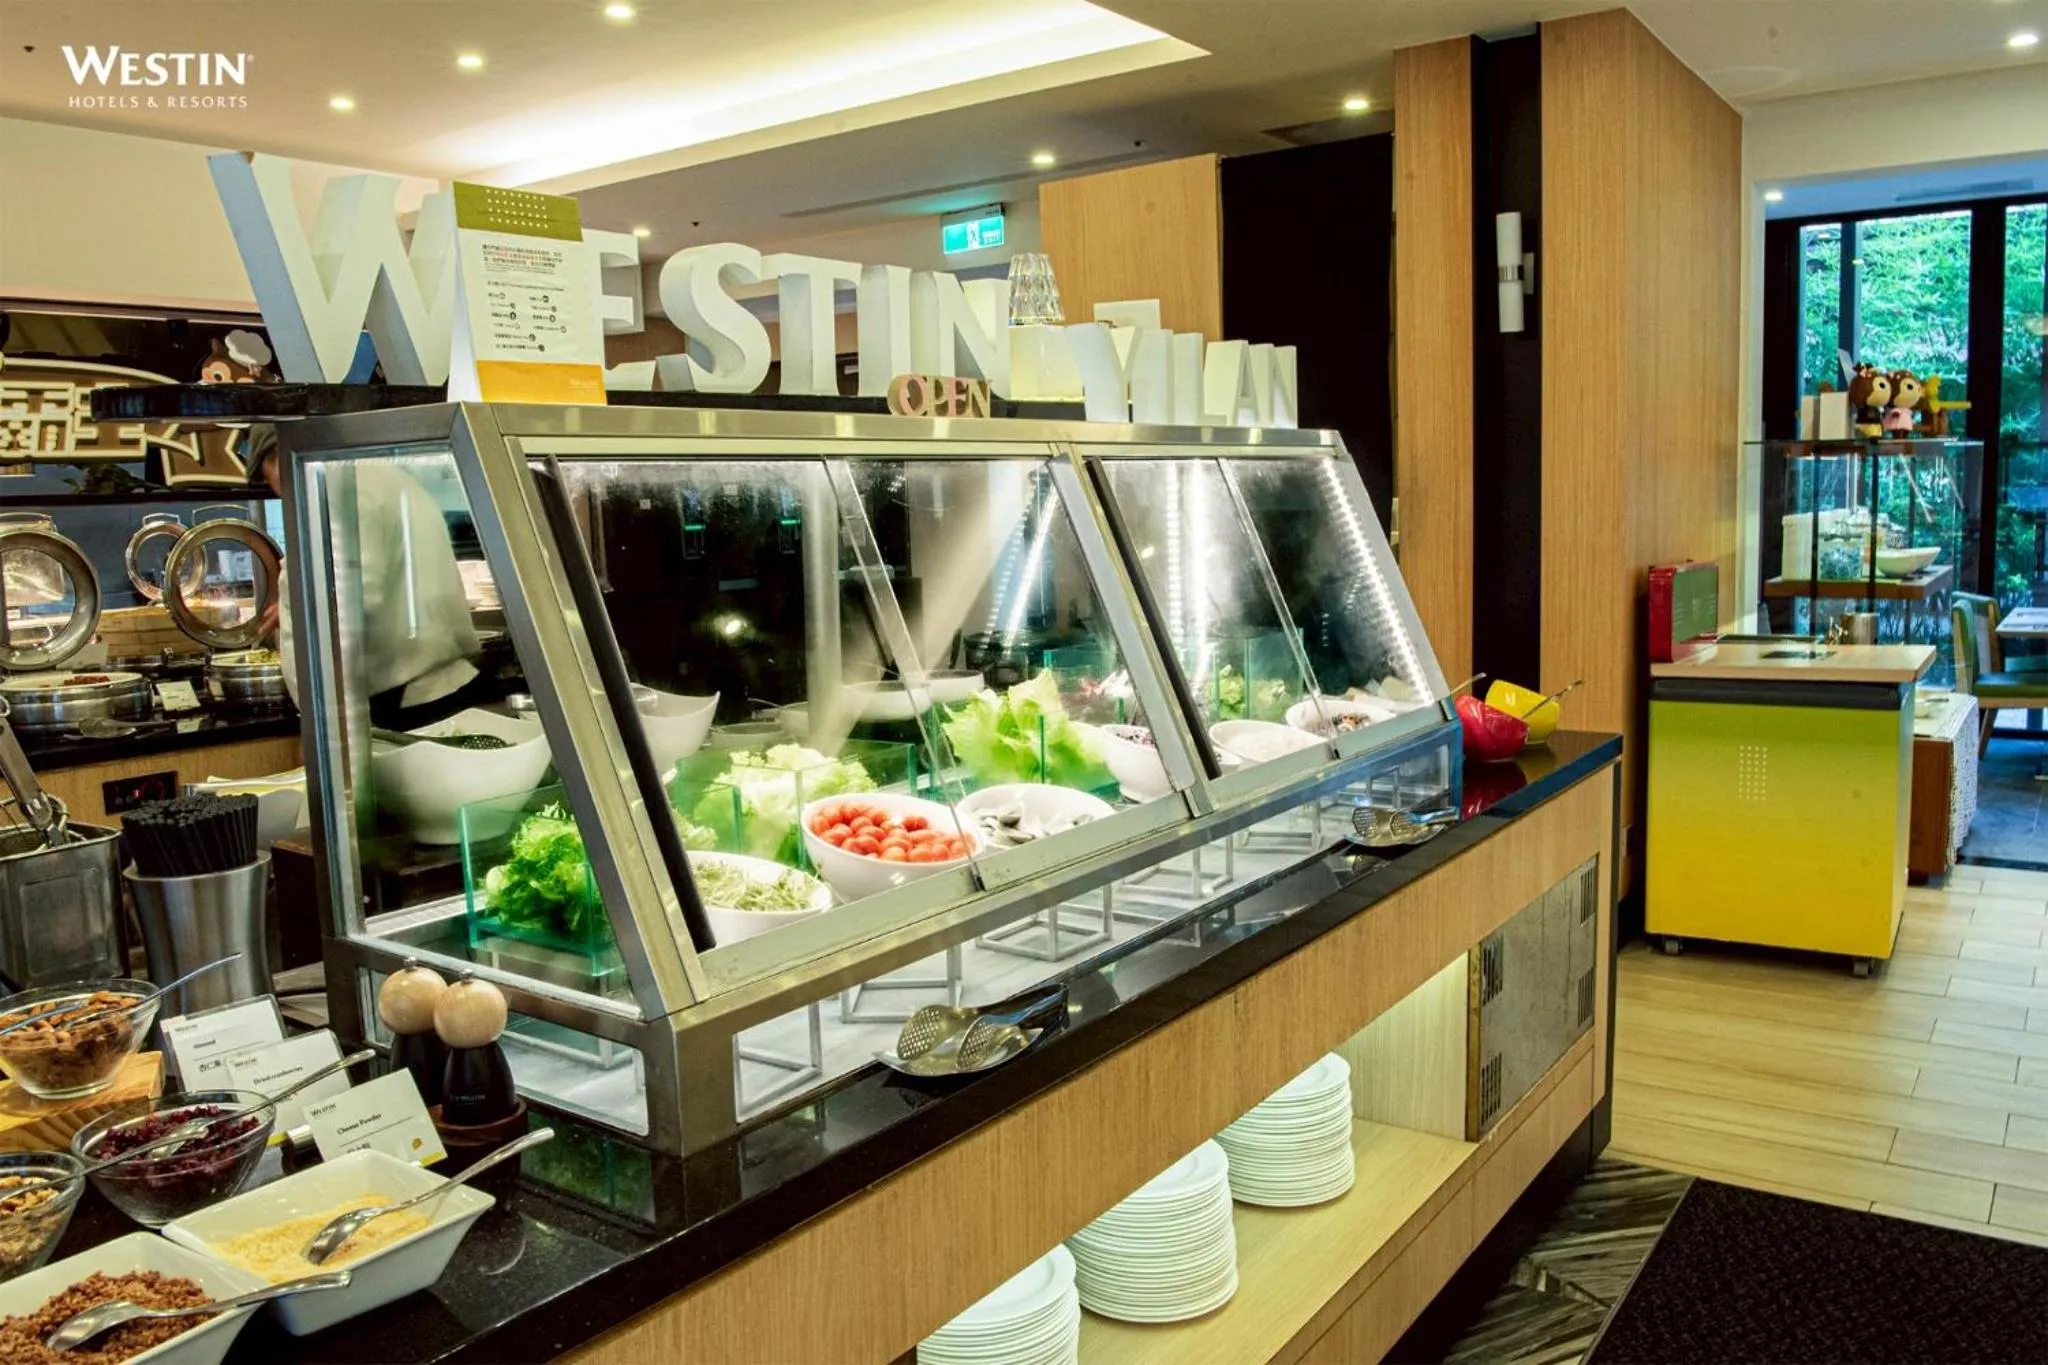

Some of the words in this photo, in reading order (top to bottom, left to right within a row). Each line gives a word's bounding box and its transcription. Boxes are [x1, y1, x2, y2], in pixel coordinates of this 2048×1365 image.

[207, 150, 1010, 399] WESTIN
[1065, 322, 1298, 429] YILAN
[887, 375, 991, 418] OPEN
